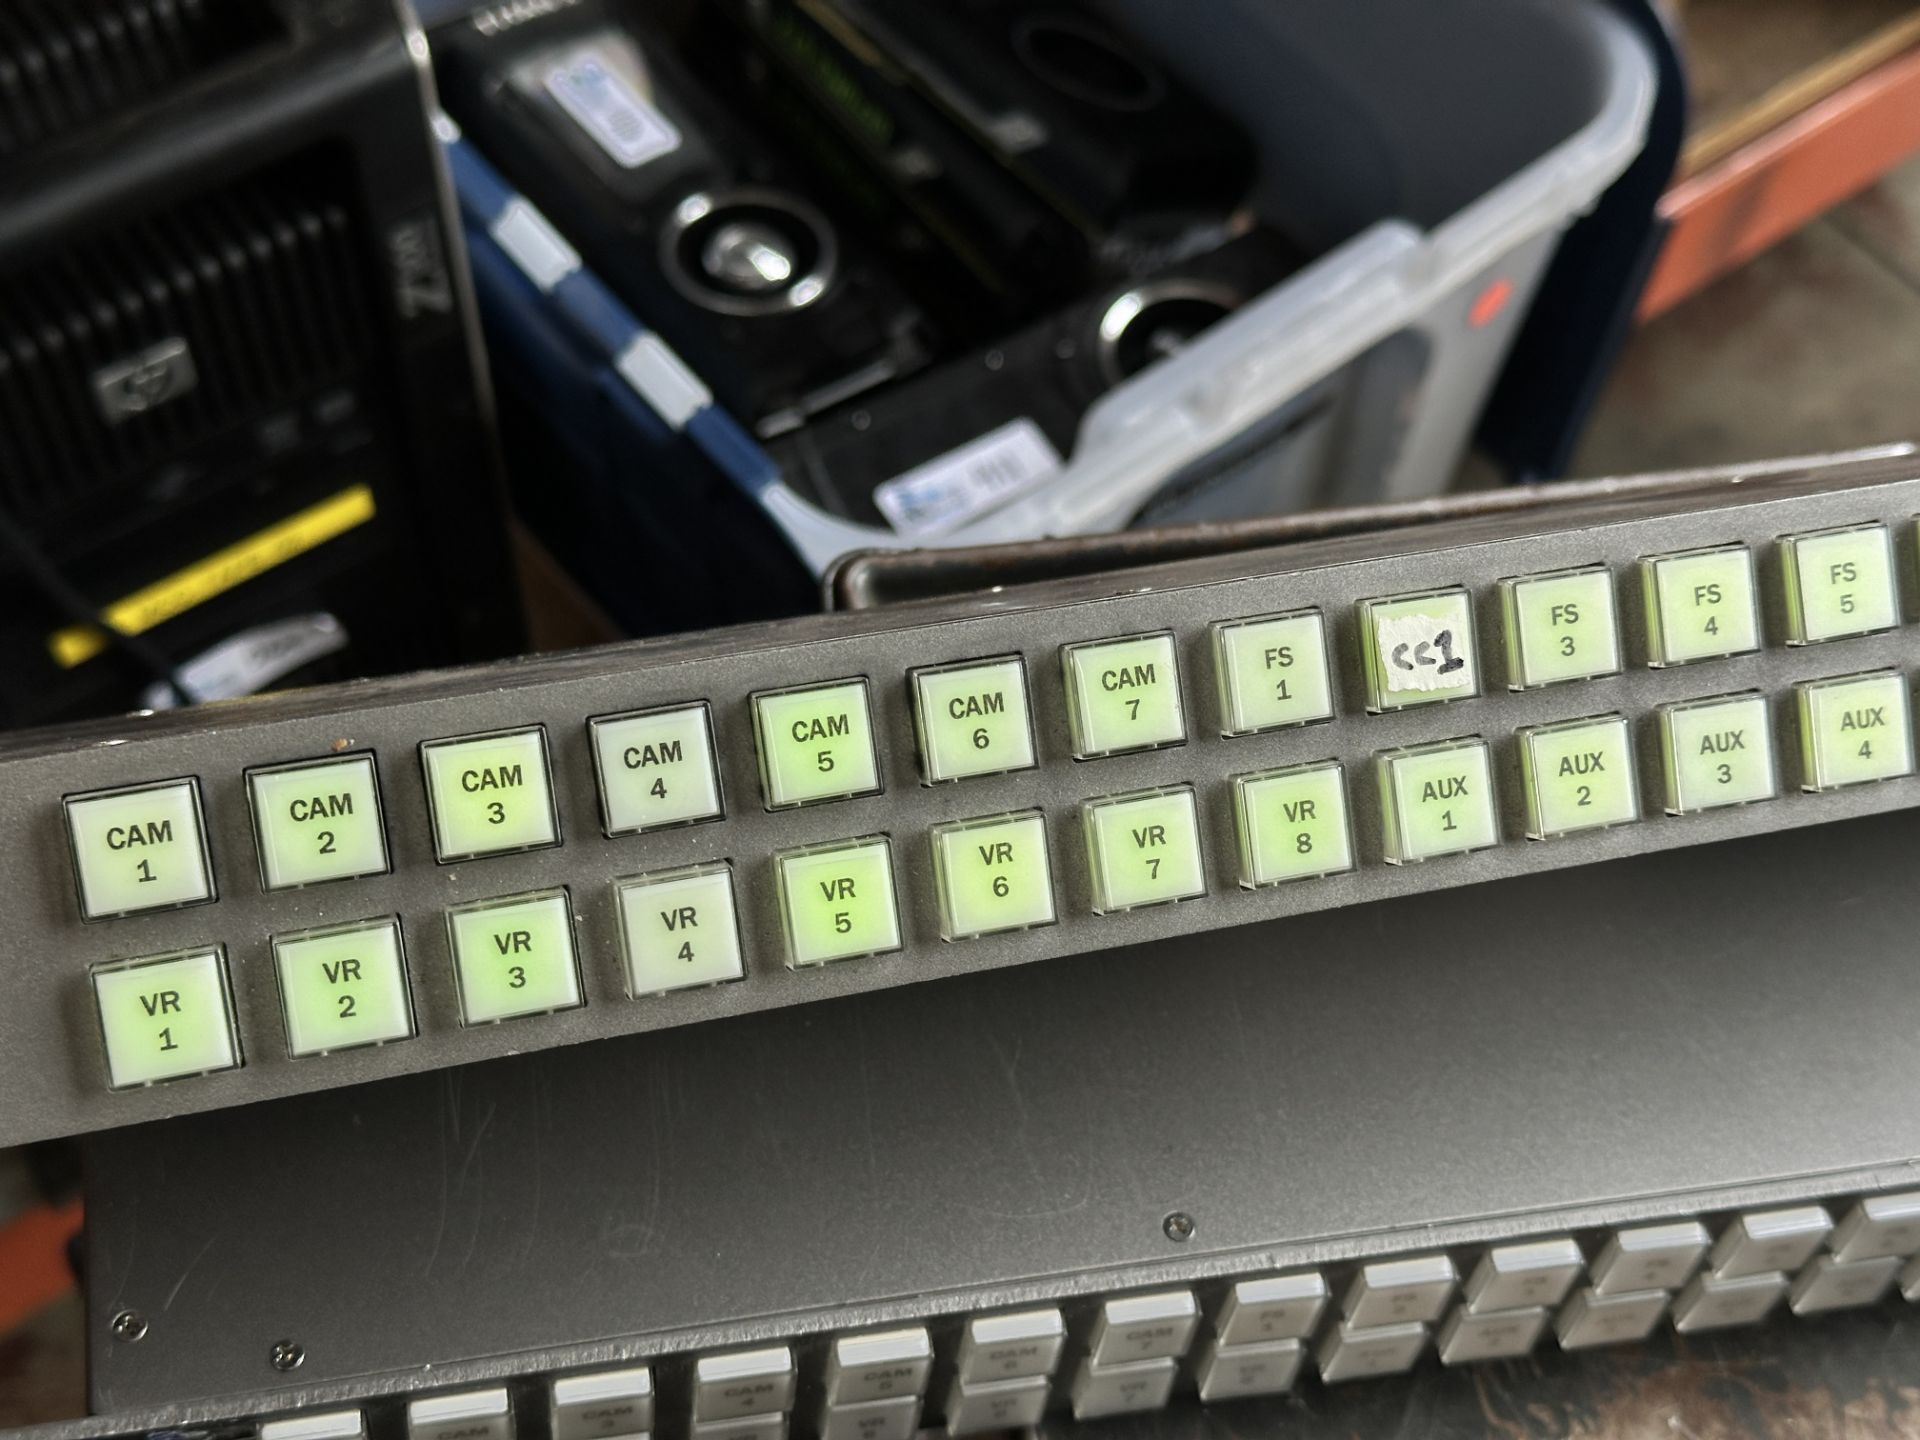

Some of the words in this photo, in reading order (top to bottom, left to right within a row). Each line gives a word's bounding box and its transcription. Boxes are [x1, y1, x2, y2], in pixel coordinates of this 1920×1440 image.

[1831, 562, 1857, 585] FS
[1694, 583, 1722, 606] FS
[1841, 594, 1854, 614] 5
[1551, 603, 1579, 626] FS
[1704, 616, 1719, 635] 4
[1264, 646, 1294, 670] FS
[1560, 636, 1576, 657] 3
[1101, 663, 1156, 692] CAM
[1276, 679, 1292, 701] 1
[948, 692, 1005, 720] CAM
[1124, 698, 1140, 721] 7
[791, 713, 850, 743] CAM
[1841, 707, 1885, 731] AUX
[972, 727, 990, 750] 6
[1699, 730, 1745, 756] AUX
[1858, 740, 1872, 759] 4
[623, 739, 683, 770] CAM
[817, 750, 835, 773] 5
[1558, 751, 1605, 777] AUX
[461, 764, 523, 793] CAM
[1717, 763, 1732, 784] 3
[650, 777, 668, 799] 4
[1422, 775, 1469, 803] AUX
[1576, 785, 1592, 807] 2
[289, 792, 354, 822] CAM
[487, 802, 506, 825] 3
[1282, 799, 1316, 823] VR
[1441, 810, 1457, 832] 1
[106, 819, 173, 851] CAM
[317, 830, 337, 855] 2
[1132, 825, 1167, 849] VR
[1296, 832, 1313, 854] 8
[978, 842, 1014, 866] VR
[136, 859, 157, 883] 1
[1145, 858, 1161, 880] 7
[819, 877, 857, 902] VR
[992, 875, 1010, 898] 6
[660, 906, 698, 932] VR
[835, 911, 852, 934] 5
[493, 930, 532, 956] VR
[677, 941, 695, 963] 4
[321, 958, 362, 985] VR
[508, 966, 527, 989] 3
[139, 990, 182, 1017] VR
[337, 995, 357, 1019] 2
[158, 1027, 179, 1052] 1
[864, 1367, 914, 1382] CAM
